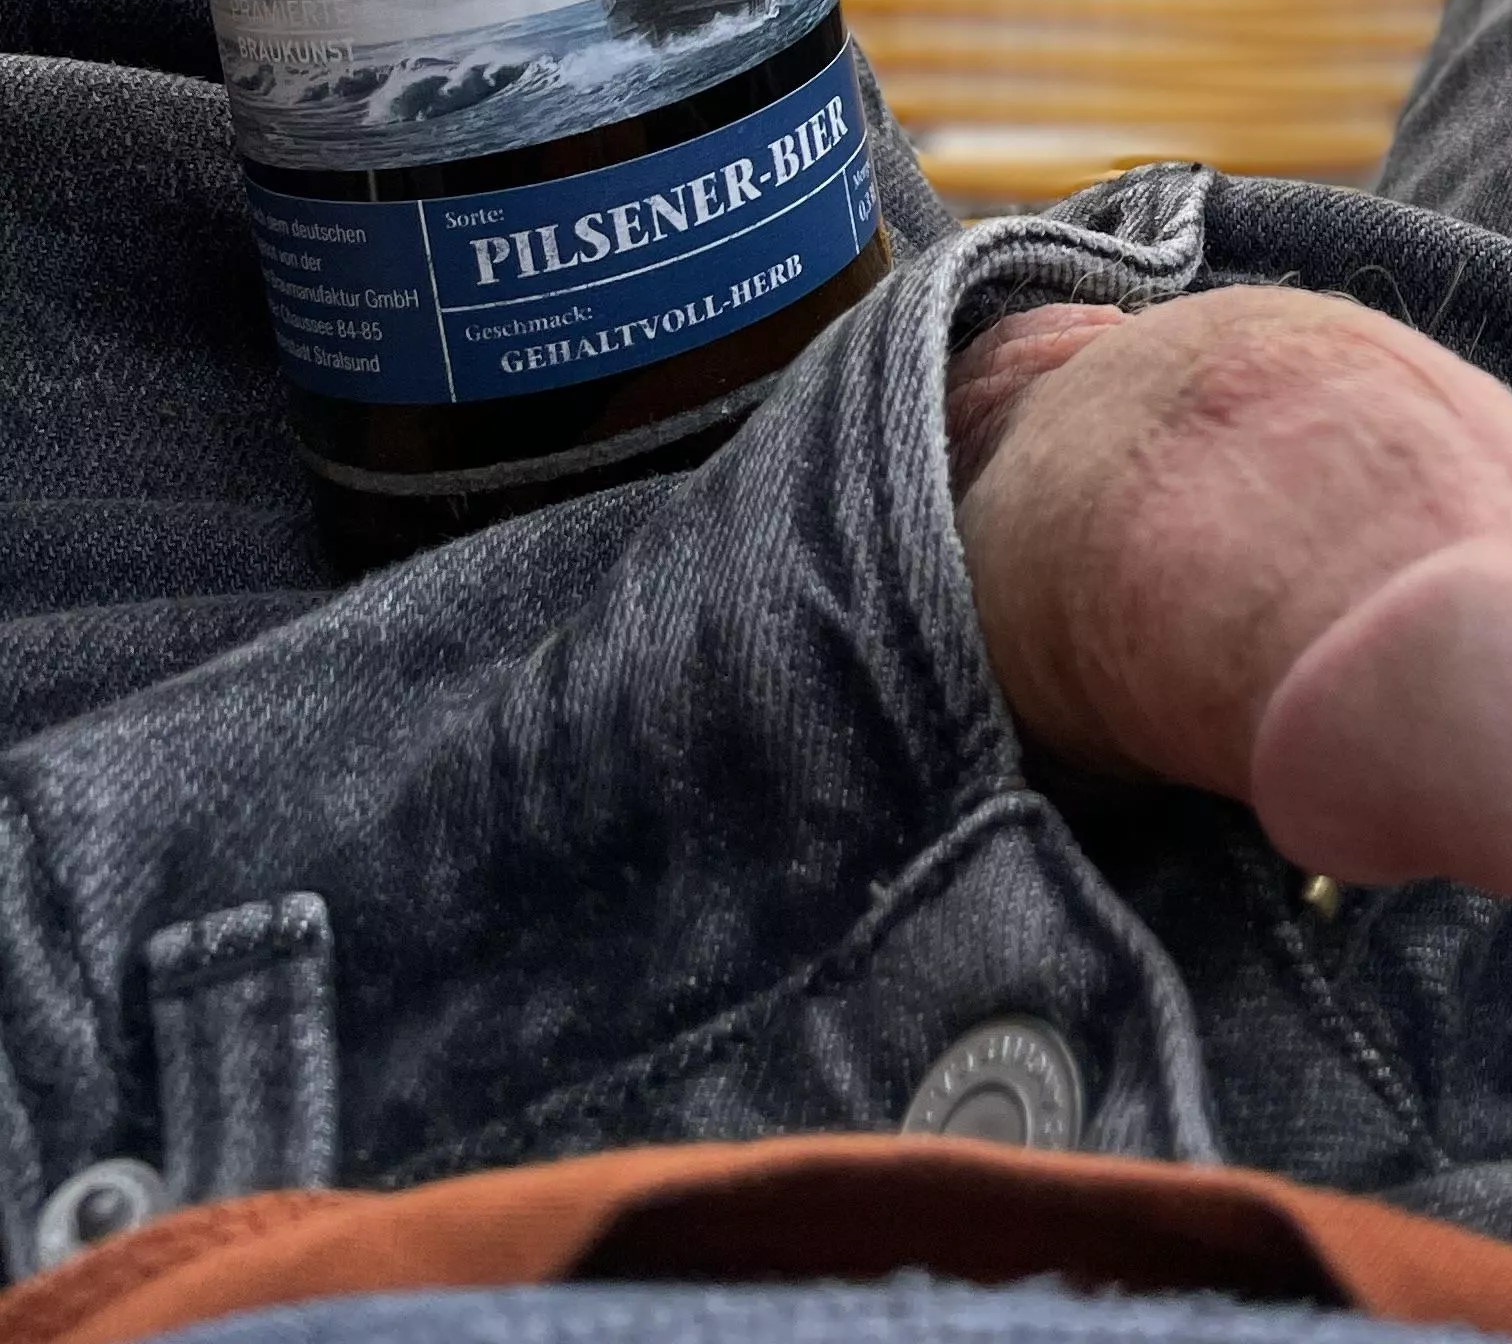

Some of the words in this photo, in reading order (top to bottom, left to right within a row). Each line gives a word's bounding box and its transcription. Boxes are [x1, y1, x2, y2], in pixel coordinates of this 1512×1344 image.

[238, 35, 356, 65] BRAUKUNST
[470, 95, 848, 286] PILSENER-BIER
[291, 217, 367, 244] deutschen
[446, 206, 505, 230] Sorte:
[301, 250, 322, 272] der
[365, 288, 419, 309] GmbH
[465, 305, 593, 342] Geschmack:
[501, 254, 804, 375] GEHALTVOLL-HERB
[337, 319, 383, 341] 84-85
[313, 344, 381, 373] Stralsund
